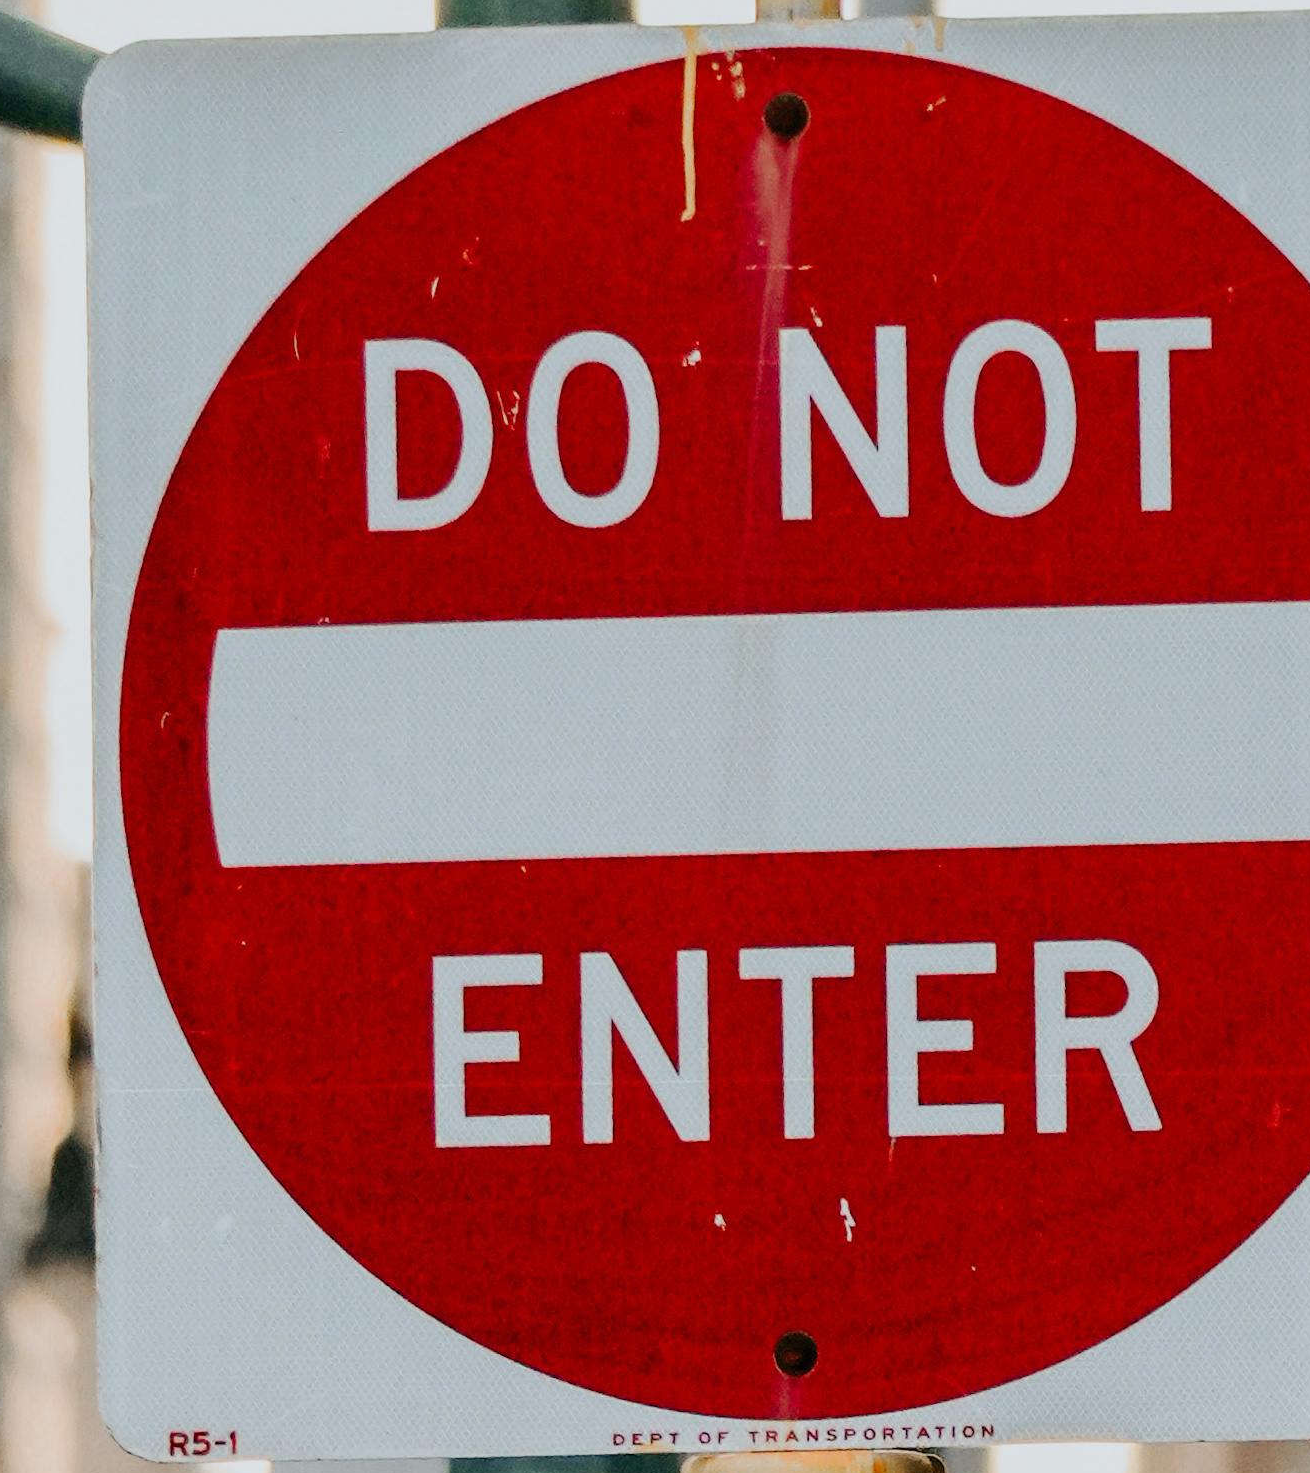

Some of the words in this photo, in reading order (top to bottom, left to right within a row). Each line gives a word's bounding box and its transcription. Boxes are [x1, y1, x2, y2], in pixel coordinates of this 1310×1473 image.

[365, 331, 660, 532] DO
[779, 317, 1212, 521] NOT
[432, 939, 1163, 1148] ENTER
[168, 1429, 238, 1457] R5-1
[612, 1431, 681, 1447] DEPT
[698, 1431, 730, 1445] OF
[749, 1424, 996, 1444] TRANSPORTATION
